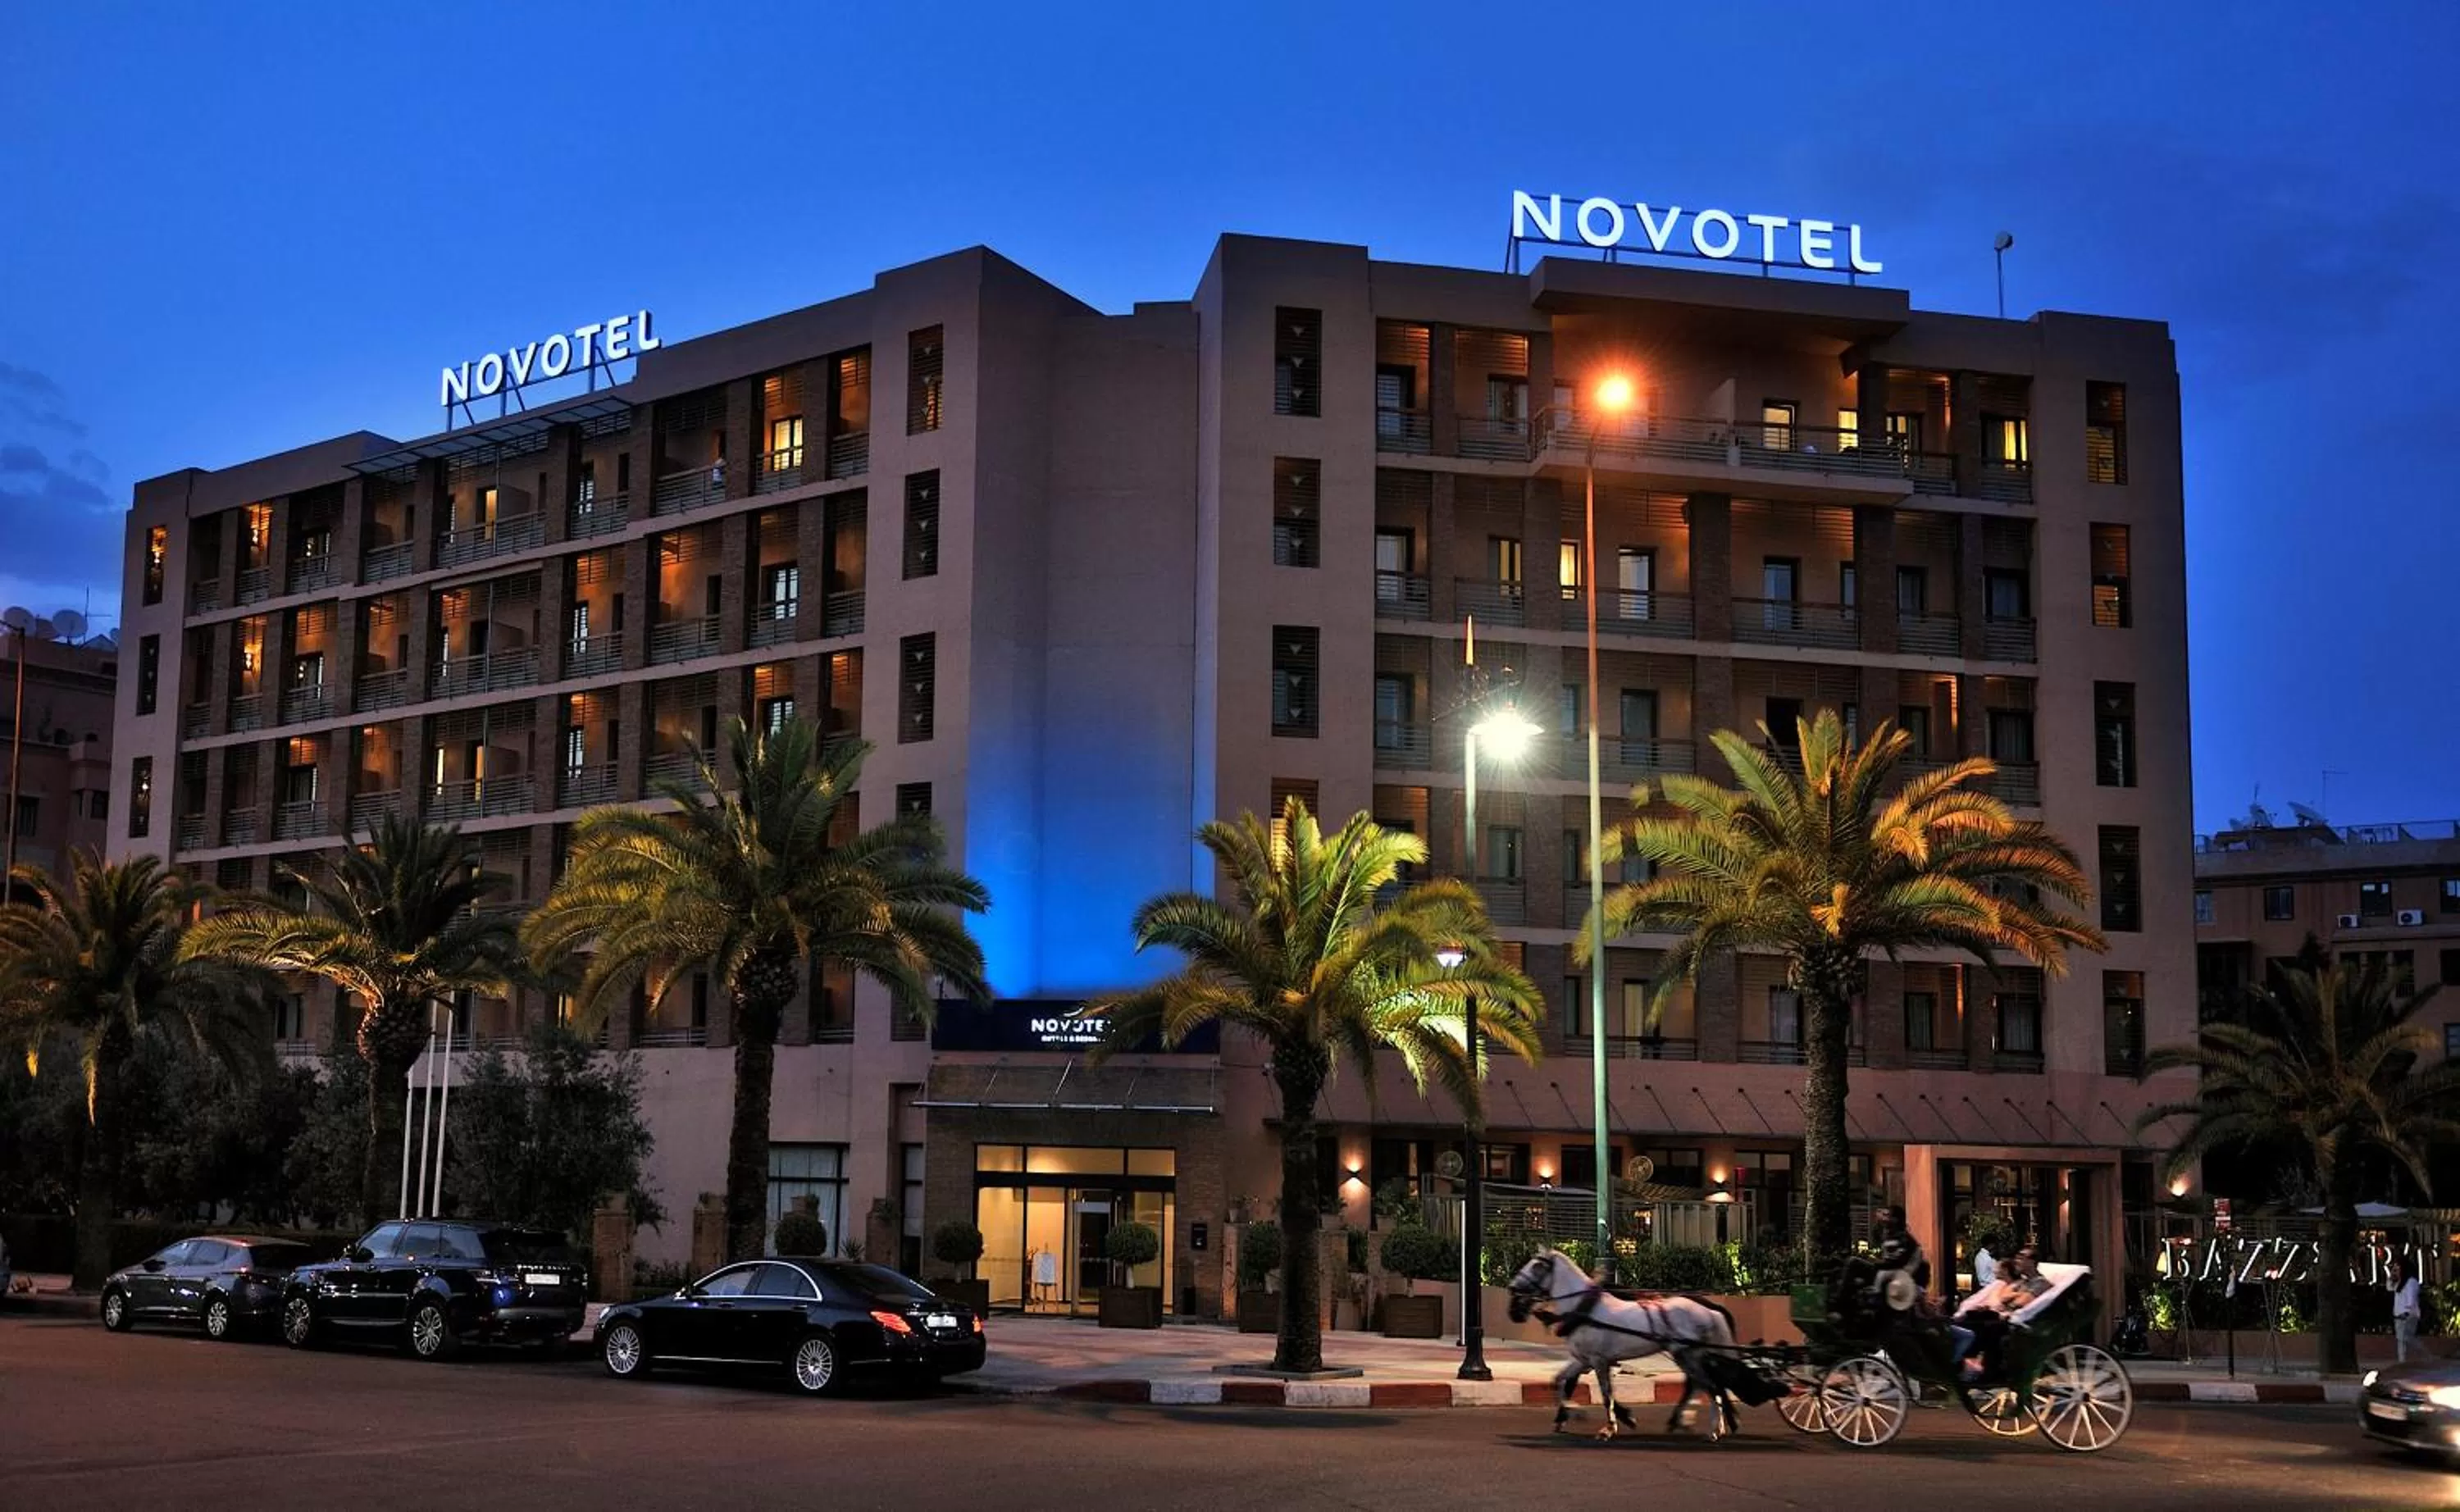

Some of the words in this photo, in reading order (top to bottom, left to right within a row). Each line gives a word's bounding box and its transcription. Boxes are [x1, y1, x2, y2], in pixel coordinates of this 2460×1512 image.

[1513, 189, 1883, 273] NOVOTEL
[440, 308, 661, 407] NOVOTEL
[1031, 1018, 1116, 1033] NOVOTE
